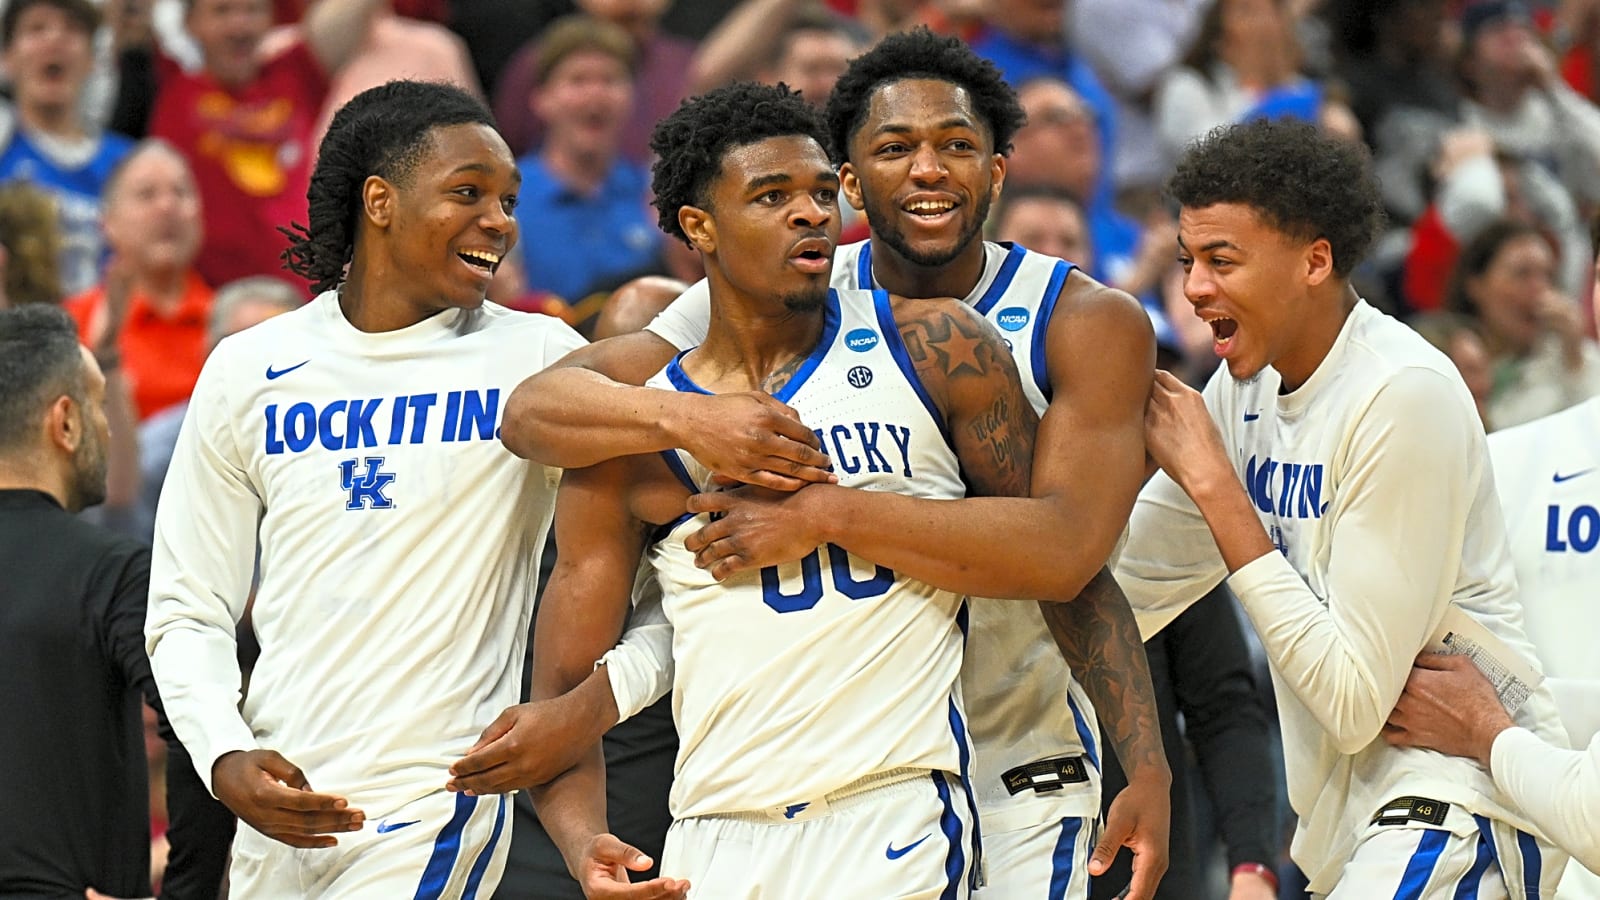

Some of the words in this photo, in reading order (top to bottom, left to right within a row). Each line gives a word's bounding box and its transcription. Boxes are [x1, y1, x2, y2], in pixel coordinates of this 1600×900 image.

[849, 367, 872, 387] SEC
[265, 398, 384, 455] LOCK
[388, 393, 438, 445] IT
[338, 457, 396, 511] UK
[1062, 765, 1075, 776] 48
[1416, 805, 1432, 816] 48
